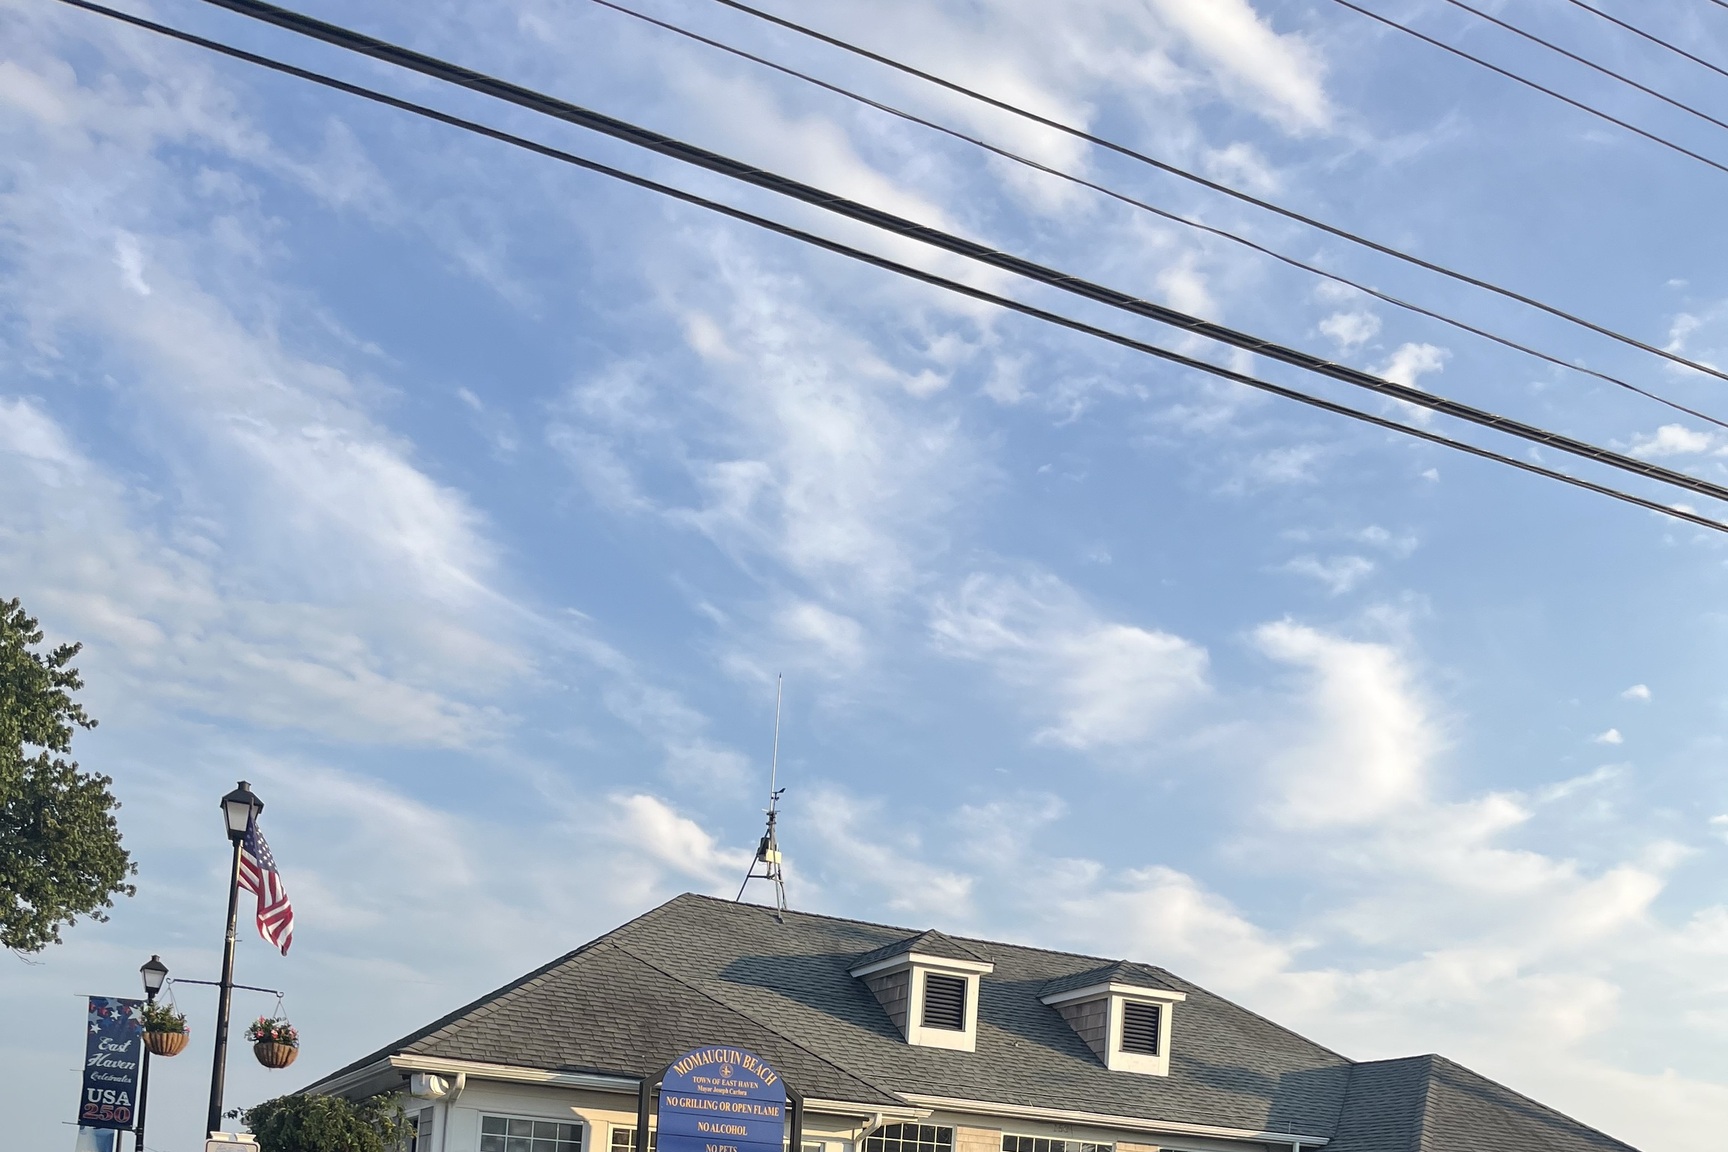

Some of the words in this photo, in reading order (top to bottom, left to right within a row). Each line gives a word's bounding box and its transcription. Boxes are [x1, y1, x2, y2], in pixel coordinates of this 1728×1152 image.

[98, 1036, 132, 1053] East
[87, 1053, 136, 1070] Haven
[672, 1049, 743, 1077] MOMAUGUIN
[742, 1054, 778, 1086] BEACH
[692, 1076, 711, 1084] TOWN
[712, 1078, 721, 1086] OF
[721, 1079, 738, 1087] EAST
[738, 1081, 759, 1089] HAVEN
[697, 1085, 712, 1093] Mayor
[87, 1088, 131, 1106] USA
[83, 1103, 131, 1123] 250
[666, 1096, 679, 1107] NO
[679, 1097, 718, 1110] GRILLING
[719, 1101, 731, 1111] OR
[731, 1103, 752, 1113] OPEN
[753, 1105, 780, 1117] FLAME
[697, 1121, 710, 1132] NO
[710, 1123, 748, 1136] ALCOHOL
